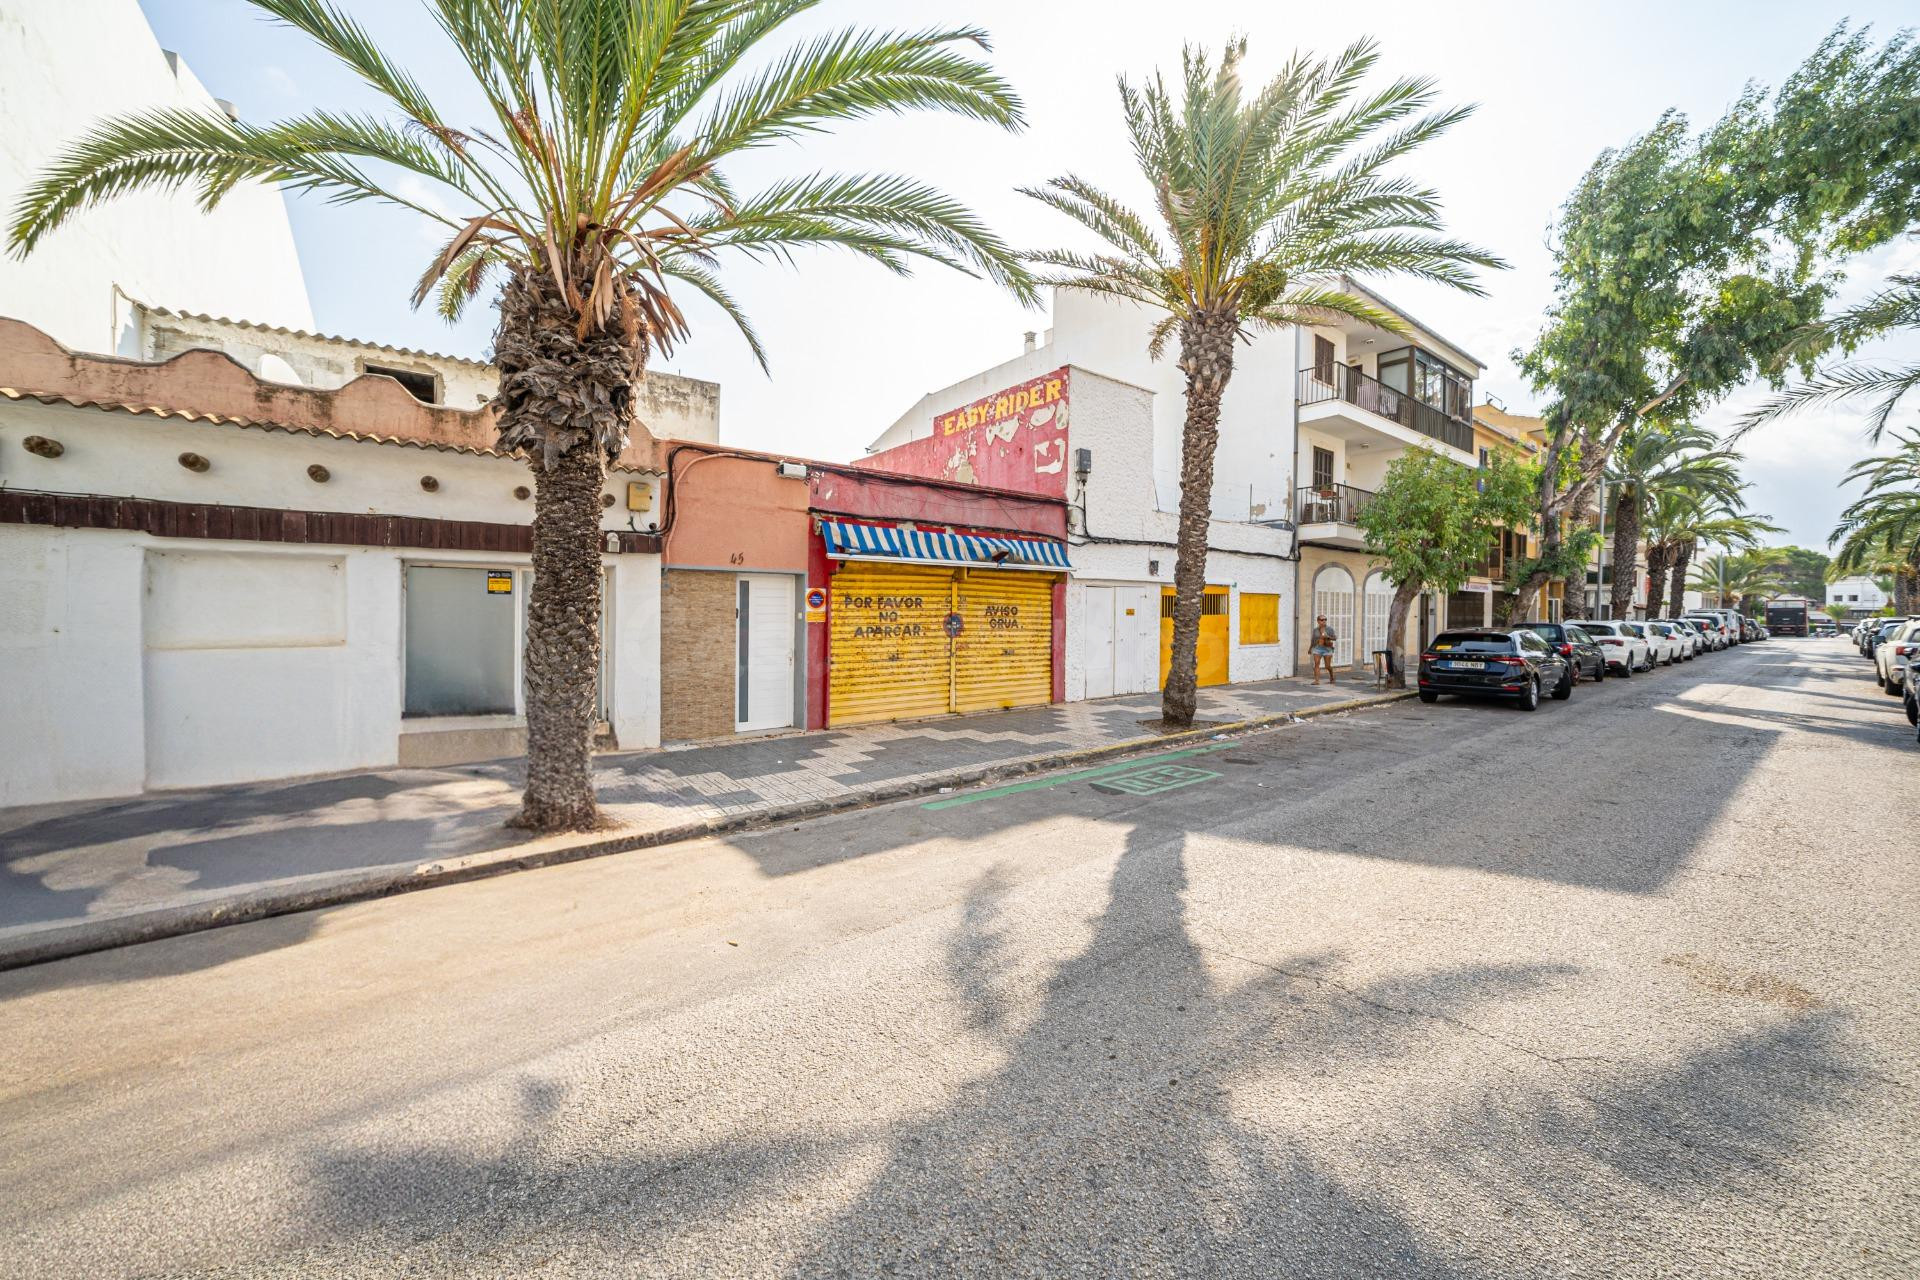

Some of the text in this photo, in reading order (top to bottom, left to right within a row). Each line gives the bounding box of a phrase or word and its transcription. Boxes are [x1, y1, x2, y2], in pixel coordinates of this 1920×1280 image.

[943, 378, 1062, 436] EASY RIDER
[730, 551, 745, 566] 45
[844, 594, 923, 610] POR FAVOR
[879, 611, 898, 622] NO
[984, 605, 1019, 616] AVISO
